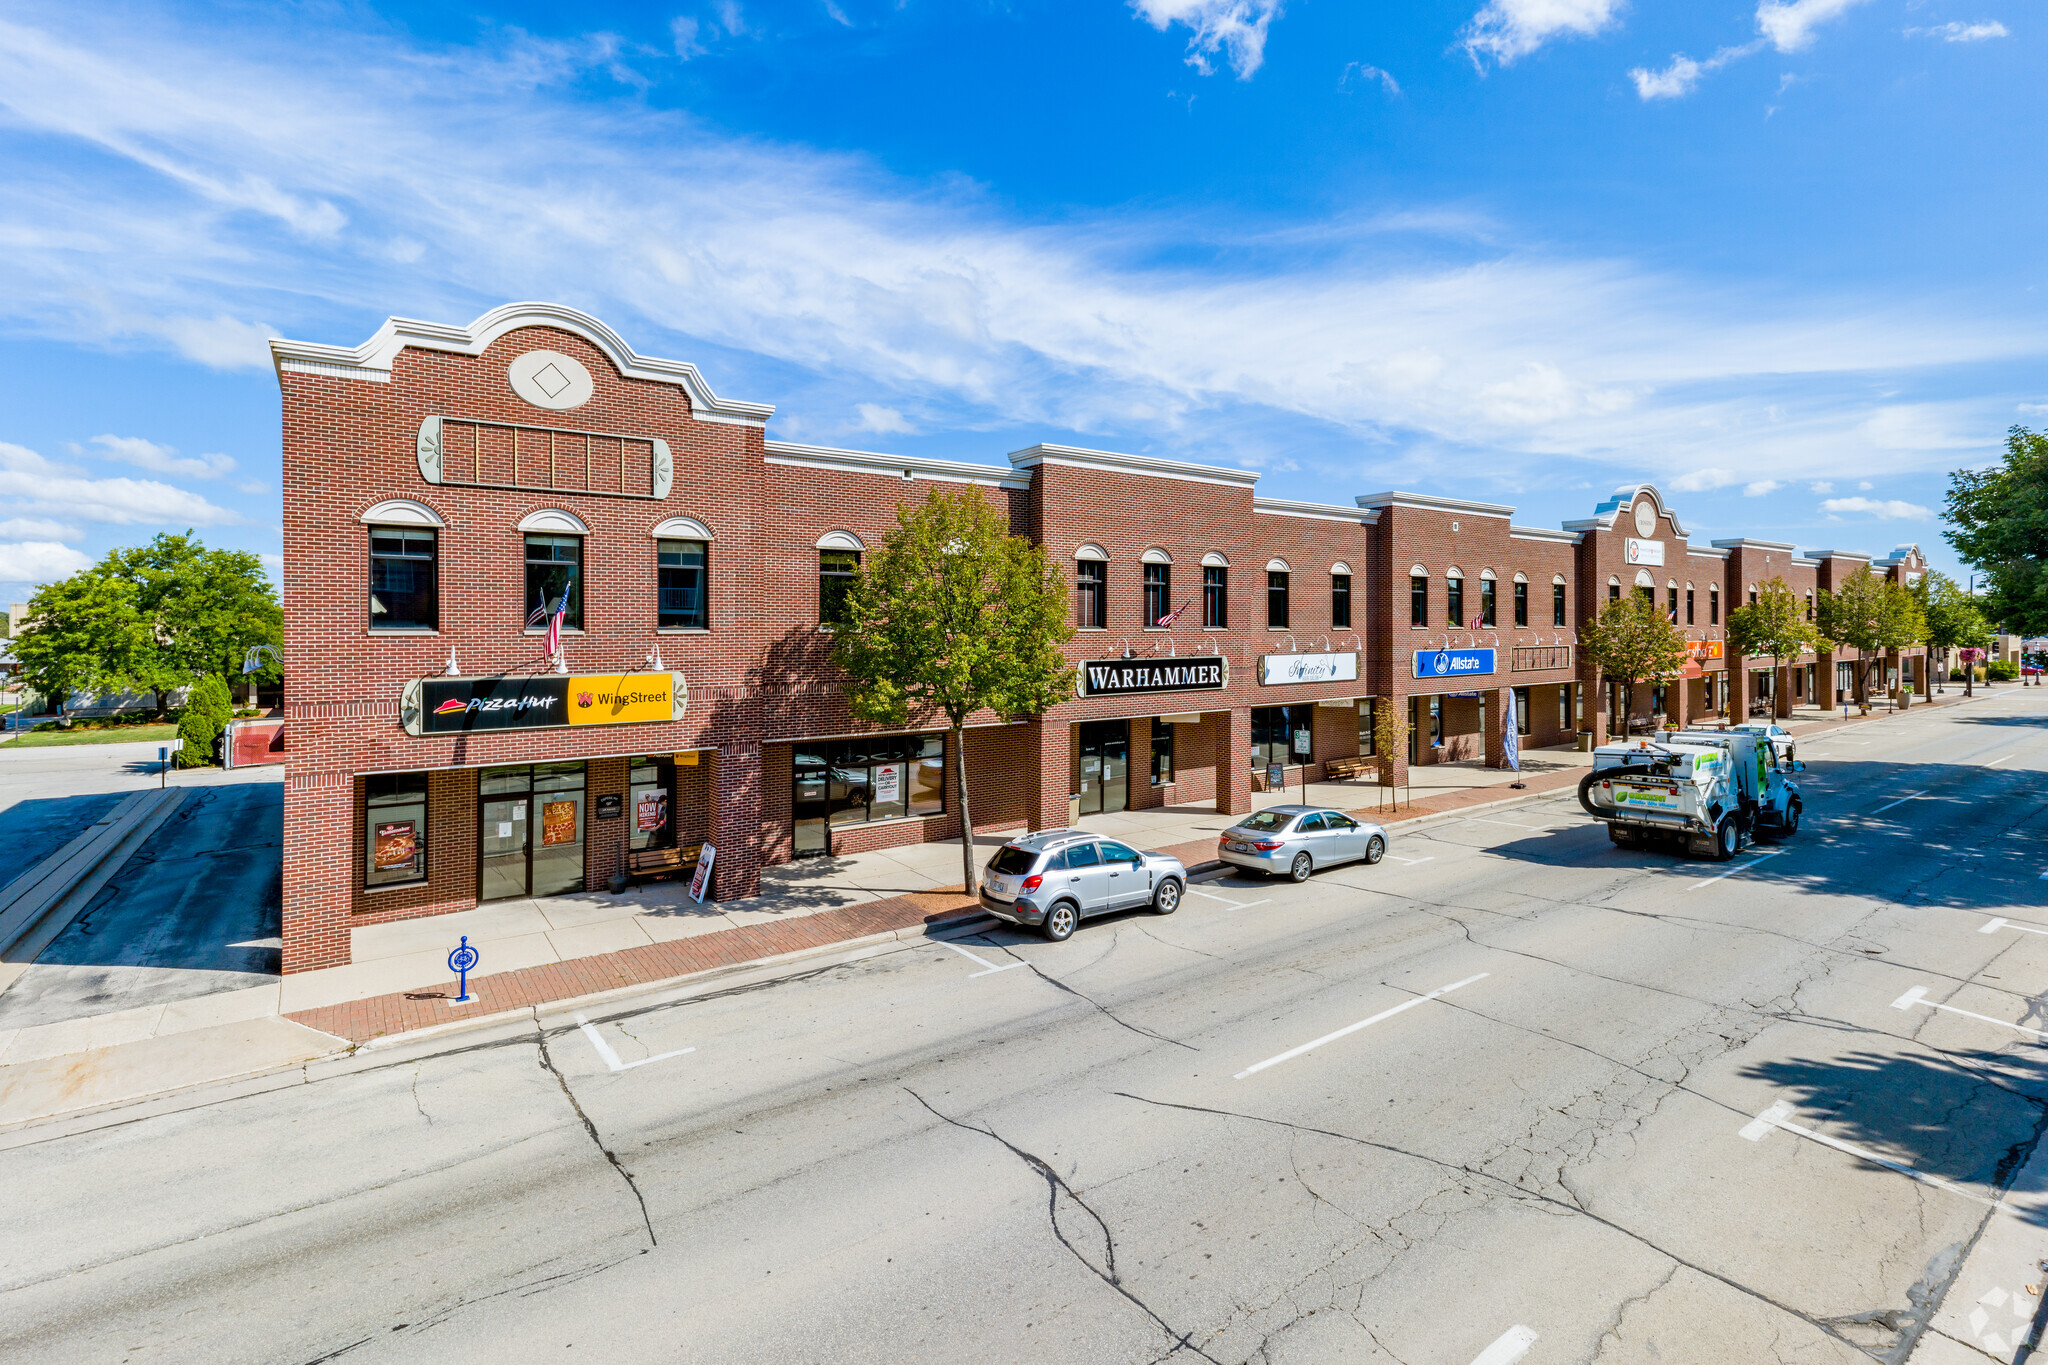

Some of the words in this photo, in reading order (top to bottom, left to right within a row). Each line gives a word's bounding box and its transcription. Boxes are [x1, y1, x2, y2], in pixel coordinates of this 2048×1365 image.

[1289, 660, 1326, 678] Infinity
[1449, 656, 1480, 670] Allstate
[1088, 665, 1221, 690] WARHAMMER
[465, 697, 518, 714] Pizza
[517, 695, 558, 712] Hut
[597, 691, 667, 706] WingStreet
[877, 775, 898, 783] DELIVERY
[1628, 792, 1667, 803] GREEN!
[638, 802, 657, 813] NOW
